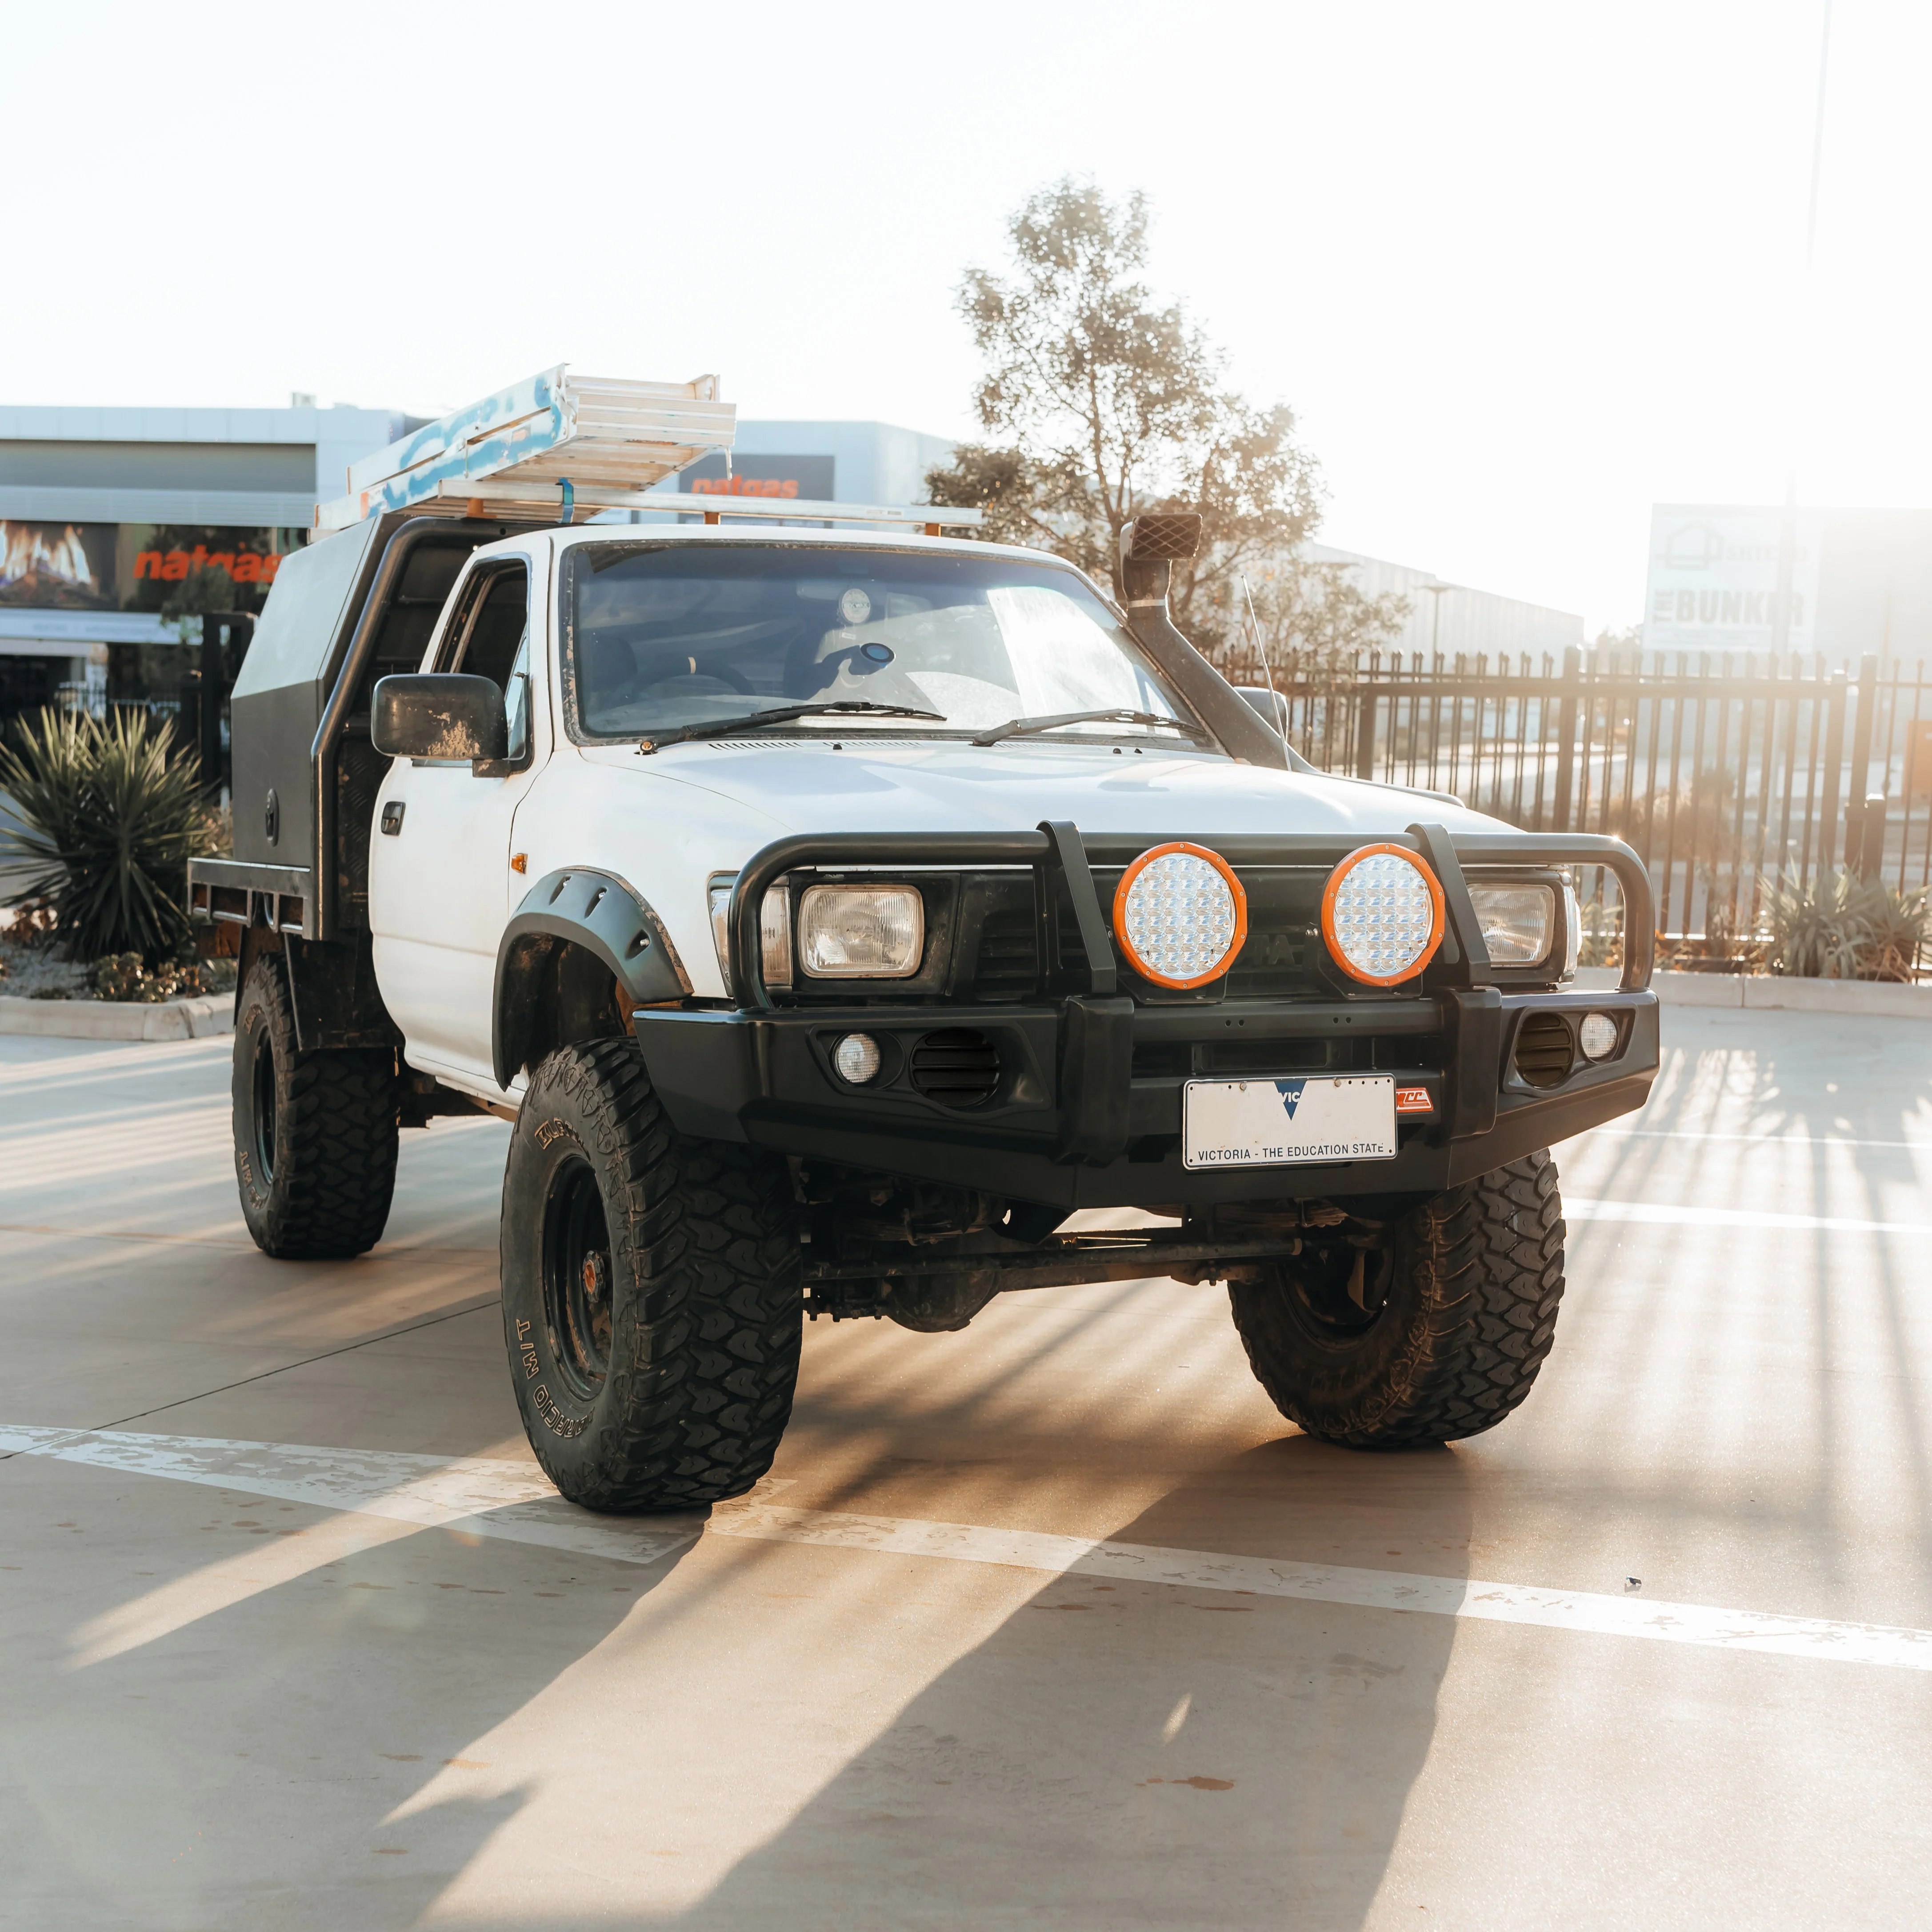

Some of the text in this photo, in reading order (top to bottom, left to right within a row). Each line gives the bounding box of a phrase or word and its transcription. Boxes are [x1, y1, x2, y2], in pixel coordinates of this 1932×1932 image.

[1279, 1092, 1300, 1103] VIC
[1198, 1149, 1251, 1161] VICTORIA
[1263, 1148, 1283, 1158] THE
[1288, 1144, 1349, 1156] EDUCATION
[1352, 1143, 1384, 1153] STATE
